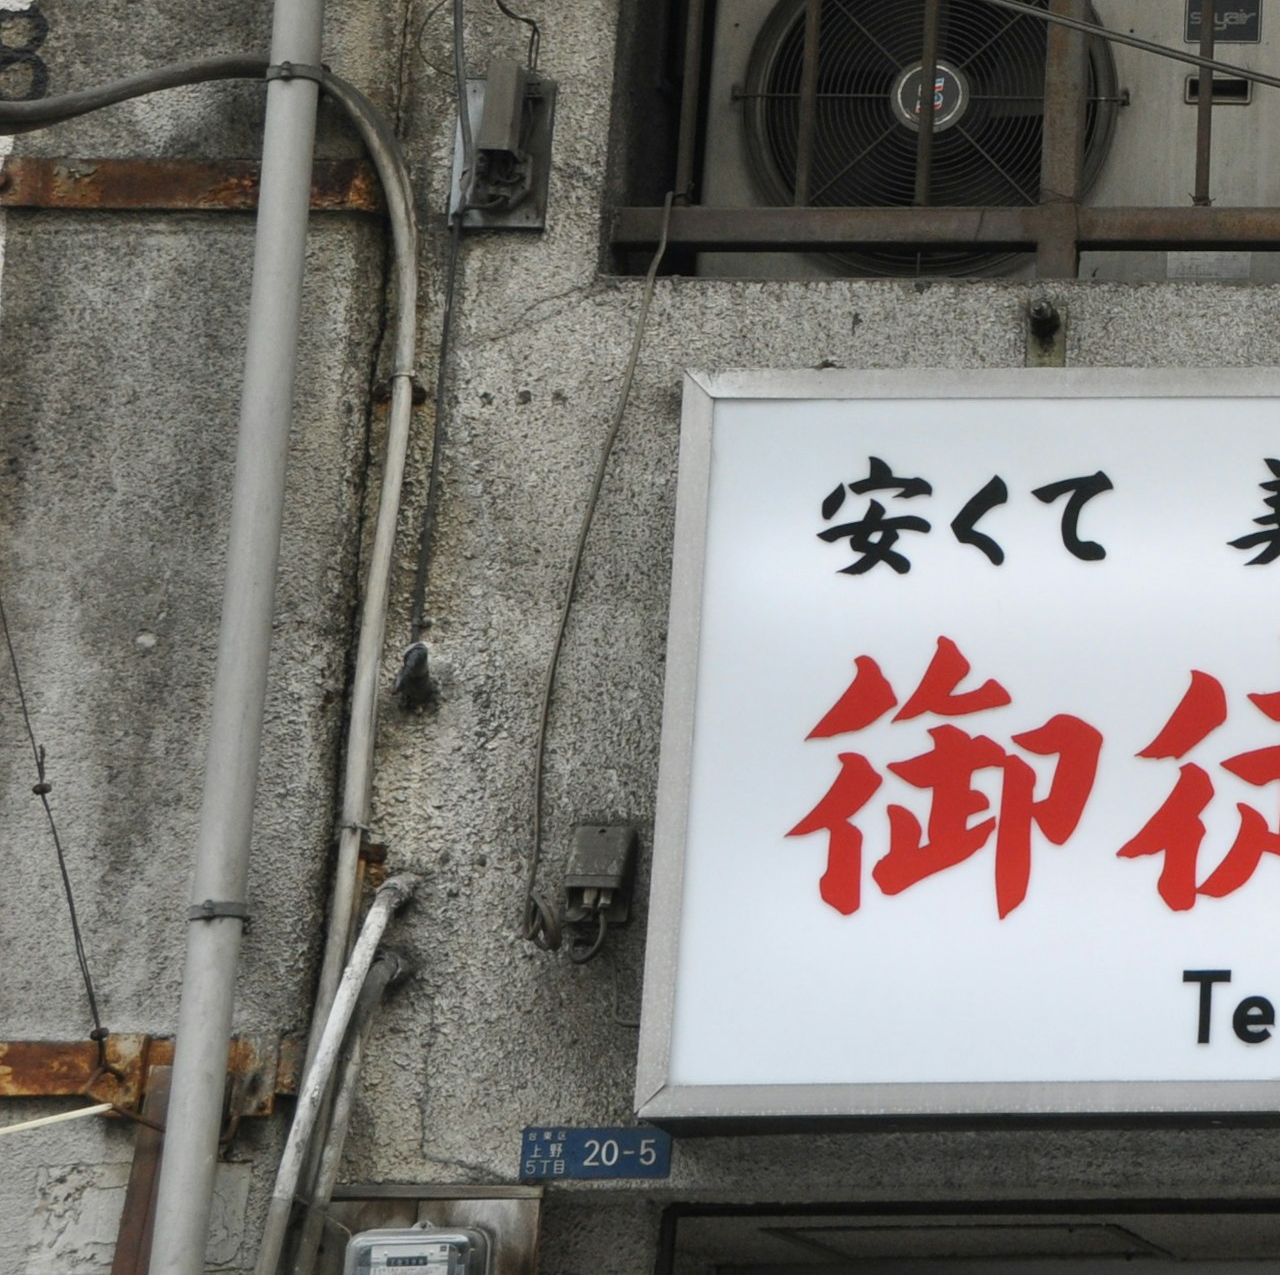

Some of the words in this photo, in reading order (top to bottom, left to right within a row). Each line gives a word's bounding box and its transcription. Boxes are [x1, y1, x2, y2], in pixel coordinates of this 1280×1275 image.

[1189, 8, 1257, 31] syair
[816, 456, 1114, 575] 安くて
[529, 1142, 563, 1158] 上野
[582, 1139, 657, 1167] 20-5
[524, 1159, 565, 1175] 5丁目
